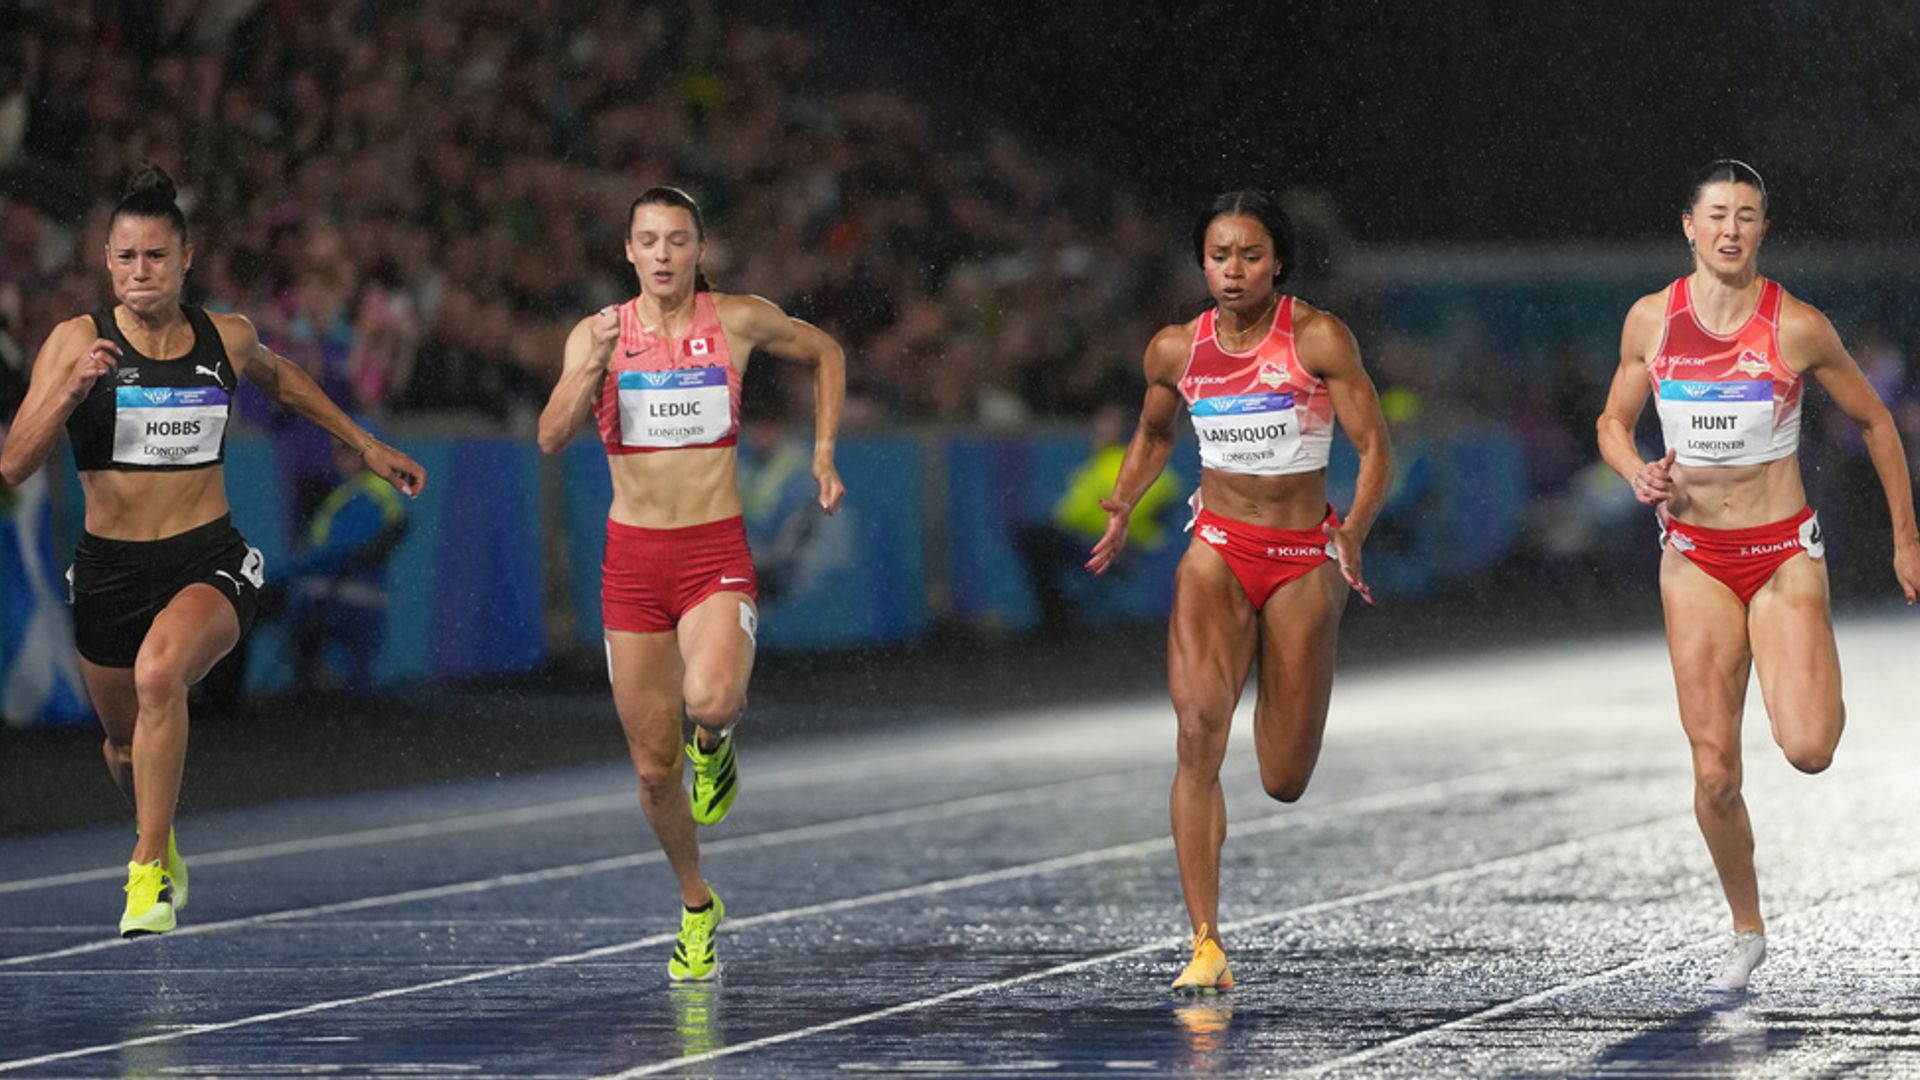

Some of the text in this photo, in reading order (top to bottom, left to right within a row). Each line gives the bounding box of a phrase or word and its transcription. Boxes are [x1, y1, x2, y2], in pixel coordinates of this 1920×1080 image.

[649, 401, 701, 418] LEDUC
[145, 421, 201, 436] HOBBS
[1691, 415, 1738, 430] HUNT
[648, 426, 704, 437] LONGINES
[1202, 423, 1287, 443] LANSIQUOT
[1688, 439, 1745, 450] LONGINES
[1751, 538, 1798, 555] KUKRI
